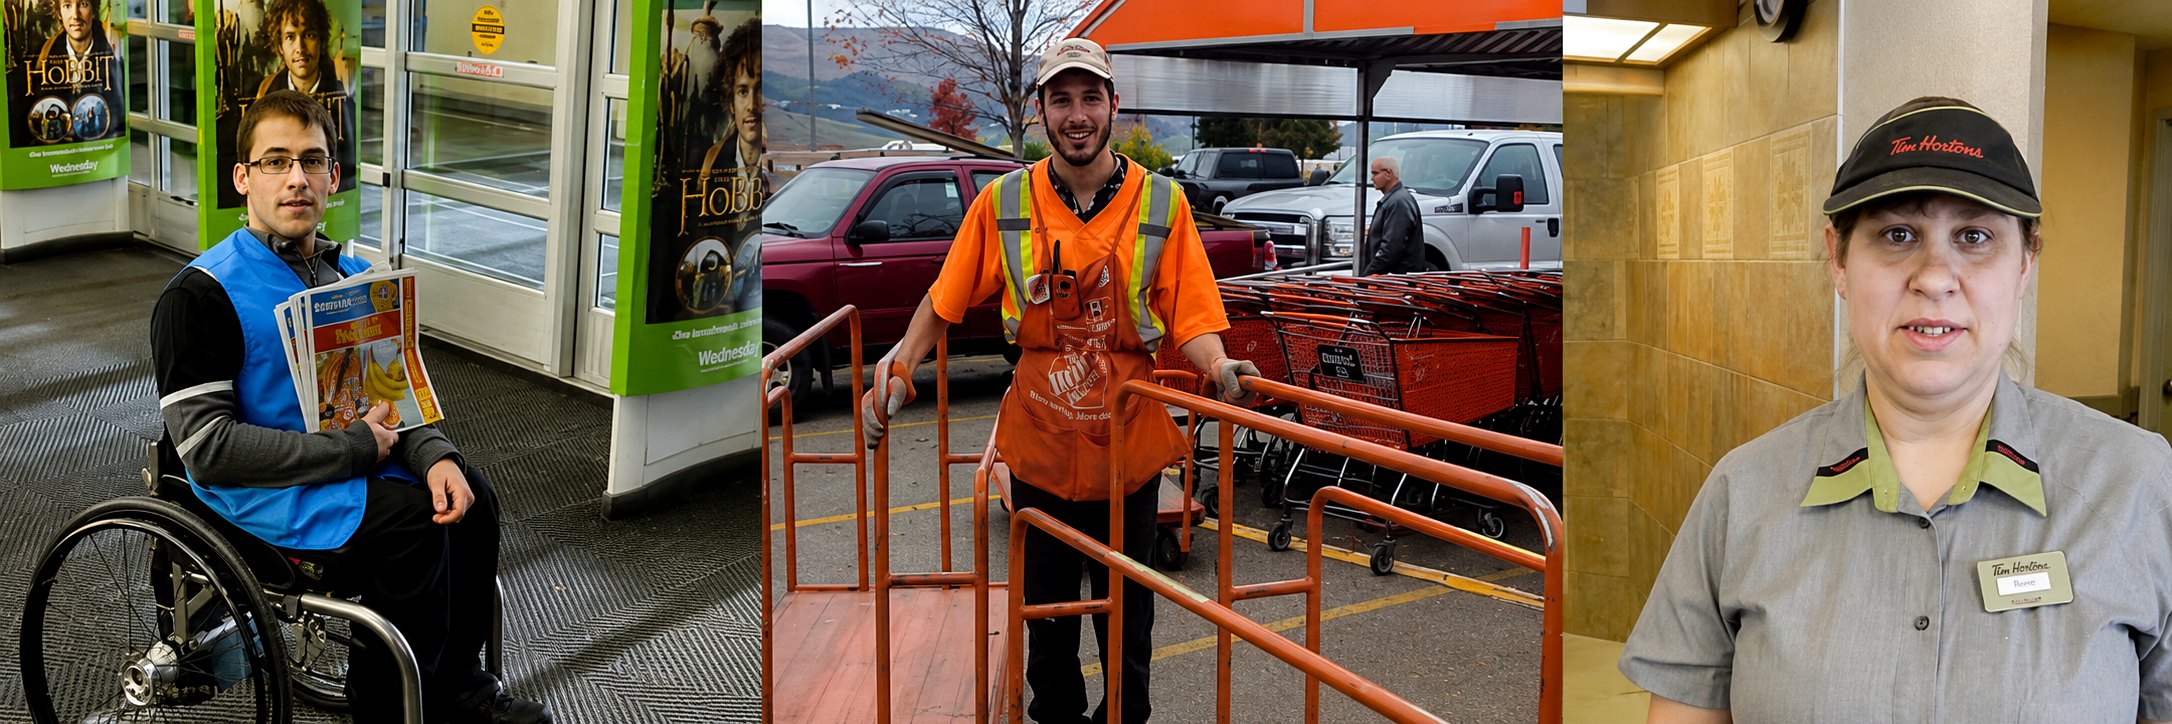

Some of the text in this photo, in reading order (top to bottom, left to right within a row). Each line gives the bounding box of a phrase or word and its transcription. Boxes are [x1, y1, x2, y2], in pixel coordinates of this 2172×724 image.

[1890, 135, 1984, 158] Tim Hortons
[49, 160, 98, 174] Wednesday
[698, 340, 761, 367] Wednesday
